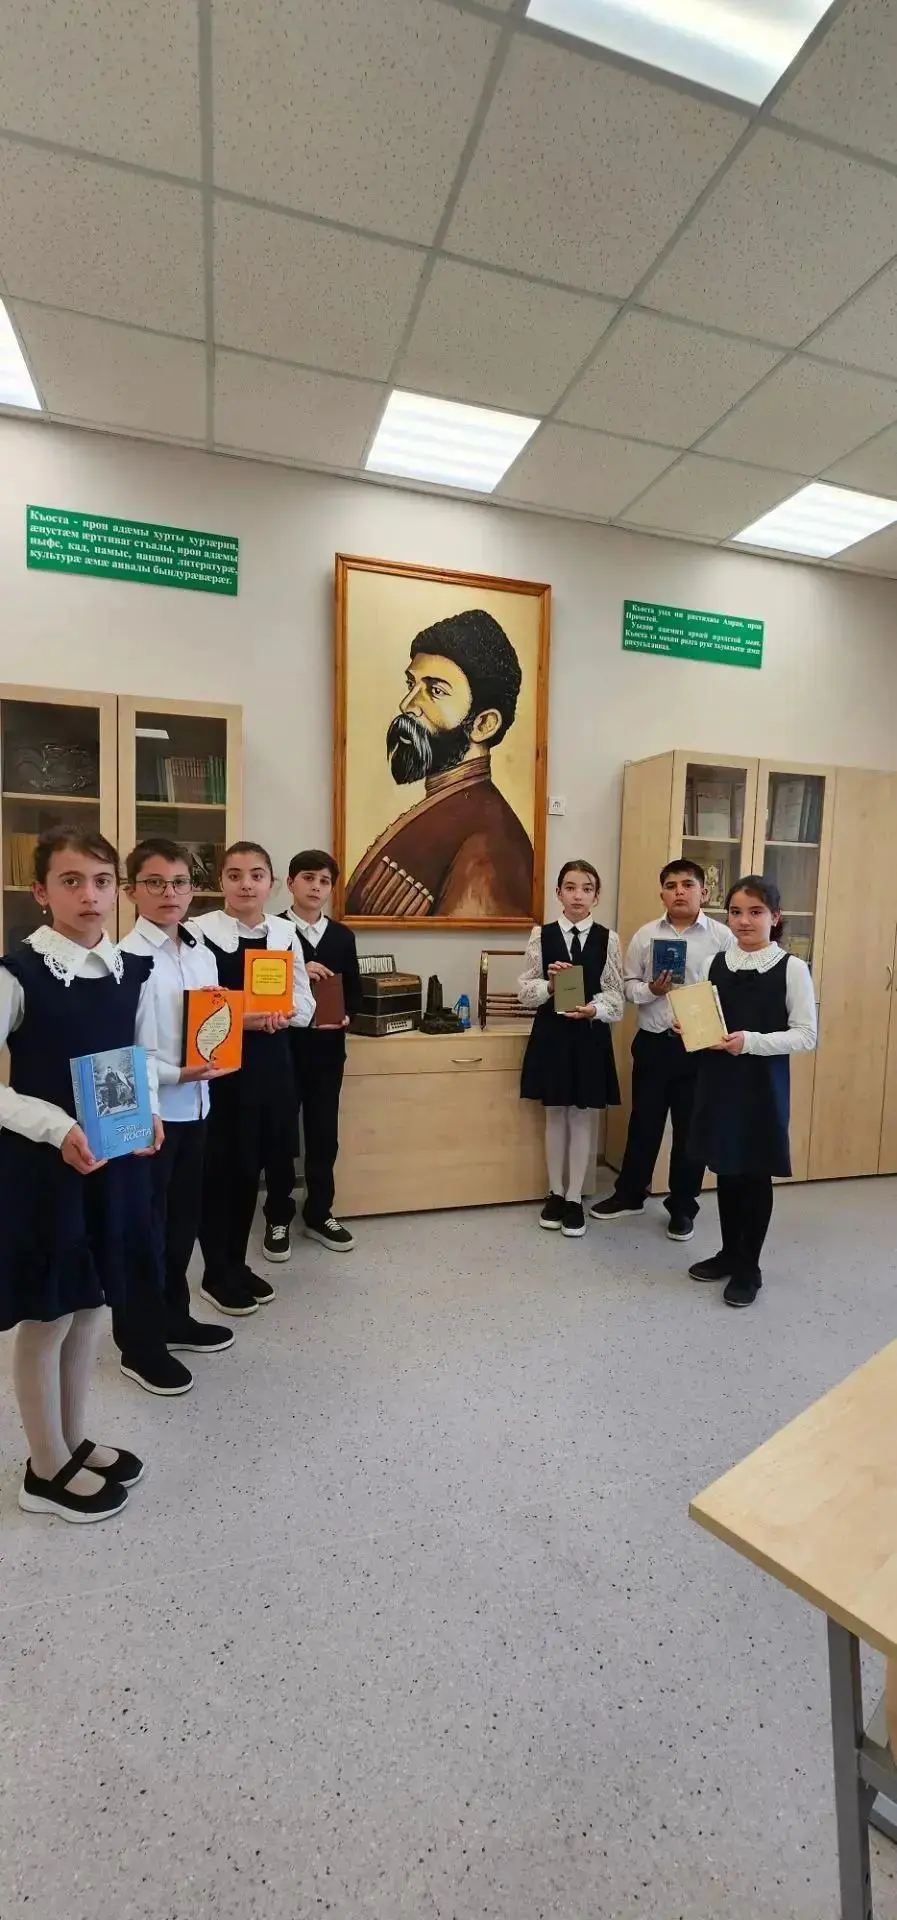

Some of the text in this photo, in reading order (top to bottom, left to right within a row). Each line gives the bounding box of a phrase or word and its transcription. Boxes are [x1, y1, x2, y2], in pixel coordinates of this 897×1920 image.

[30, 510, 69, 524] Къоста
[82, 520, 108, 531] ирон
[112, 525, 149, 536] адæмы
[153, 531, 184, 542] хурты
[189, 536, 238, 551] хурзæрин,
[30, 525, 238, 562] æнустæм æрттиваг стъалы, ирон адæмы
[30, 537, 238, 575] ныфс, кад, намыс, национ литературæ,
[30, 549, 82, 564] культурæ
[84, 557, 109, 567] æмæ
[153, 565, 232, 584] бындурæвæрæг.
